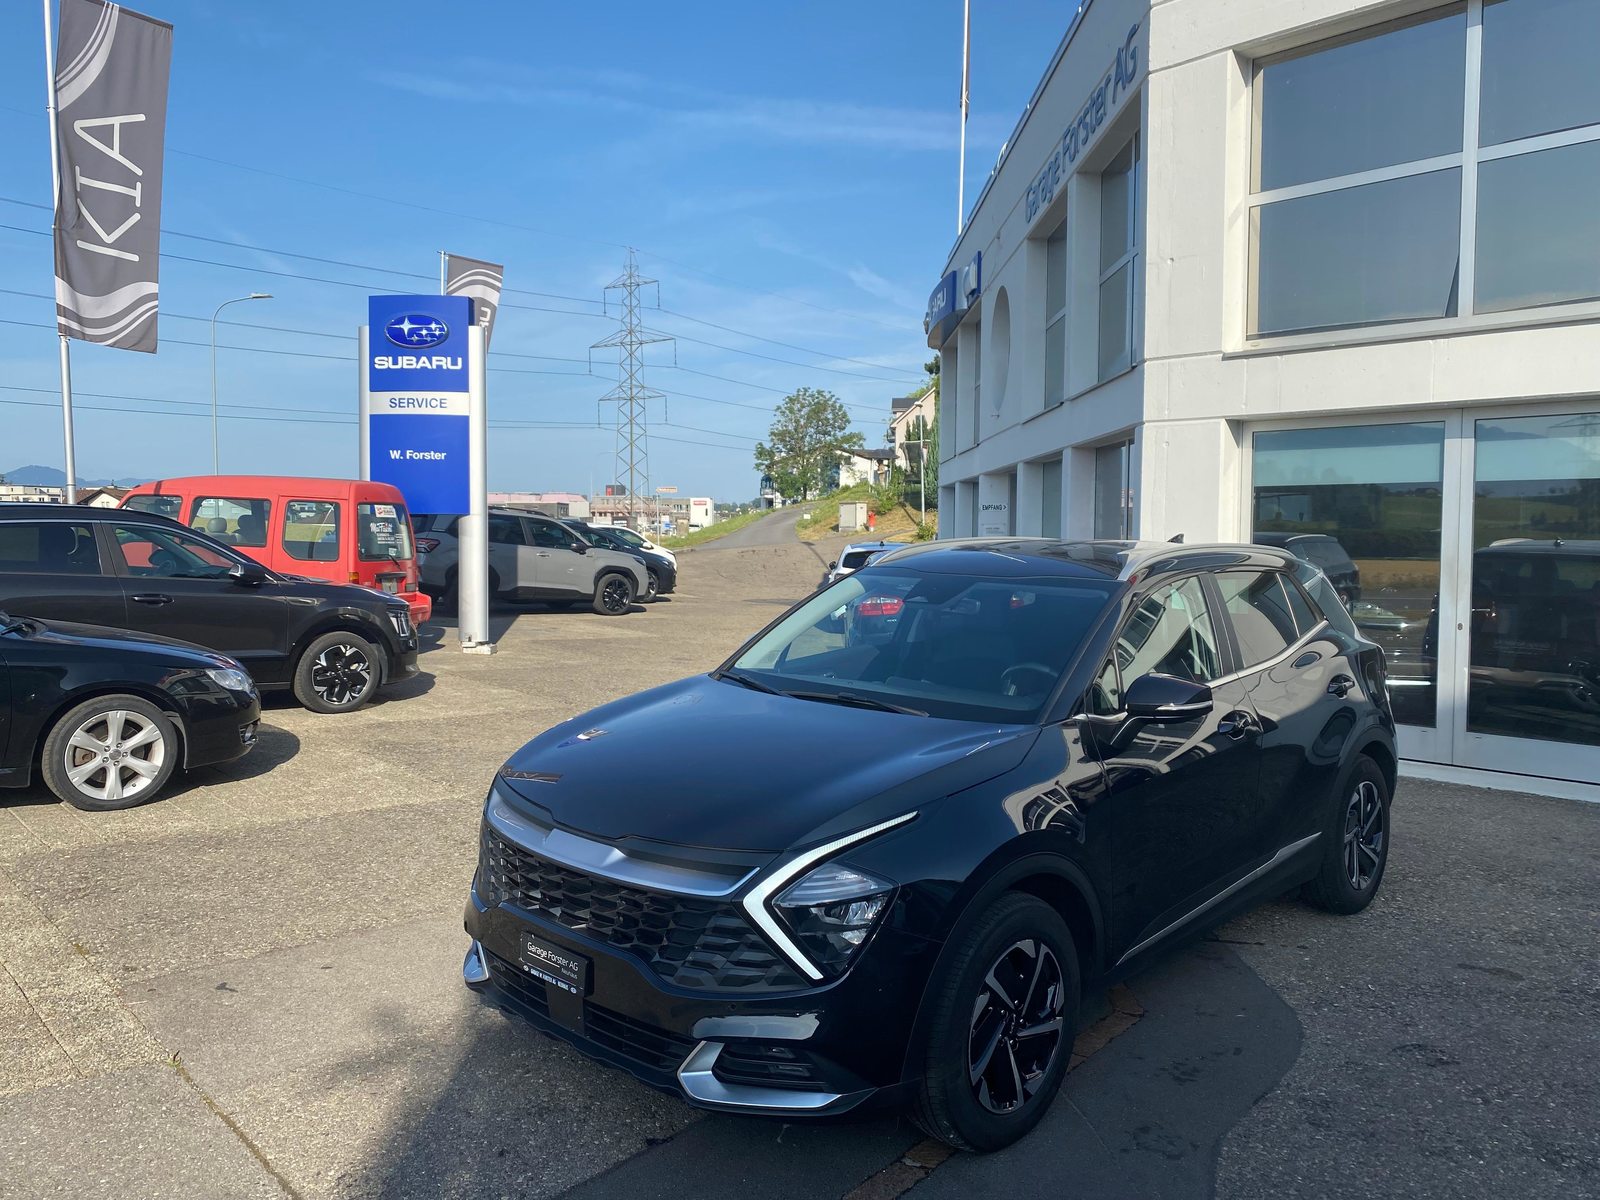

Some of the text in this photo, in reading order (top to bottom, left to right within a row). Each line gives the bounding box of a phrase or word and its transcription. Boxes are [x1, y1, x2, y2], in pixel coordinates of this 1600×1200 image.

[1025, 24, 1139, 224] Garage Forster AG
[73, 113, 146, 262] KIA
[374, 355, 462, 370] SUBARU
[389, 397, 448, 409] SERVICE
[389, 449, 447, 460] W. Forster
[527, 941, 579, 972] Garage Forster AG
